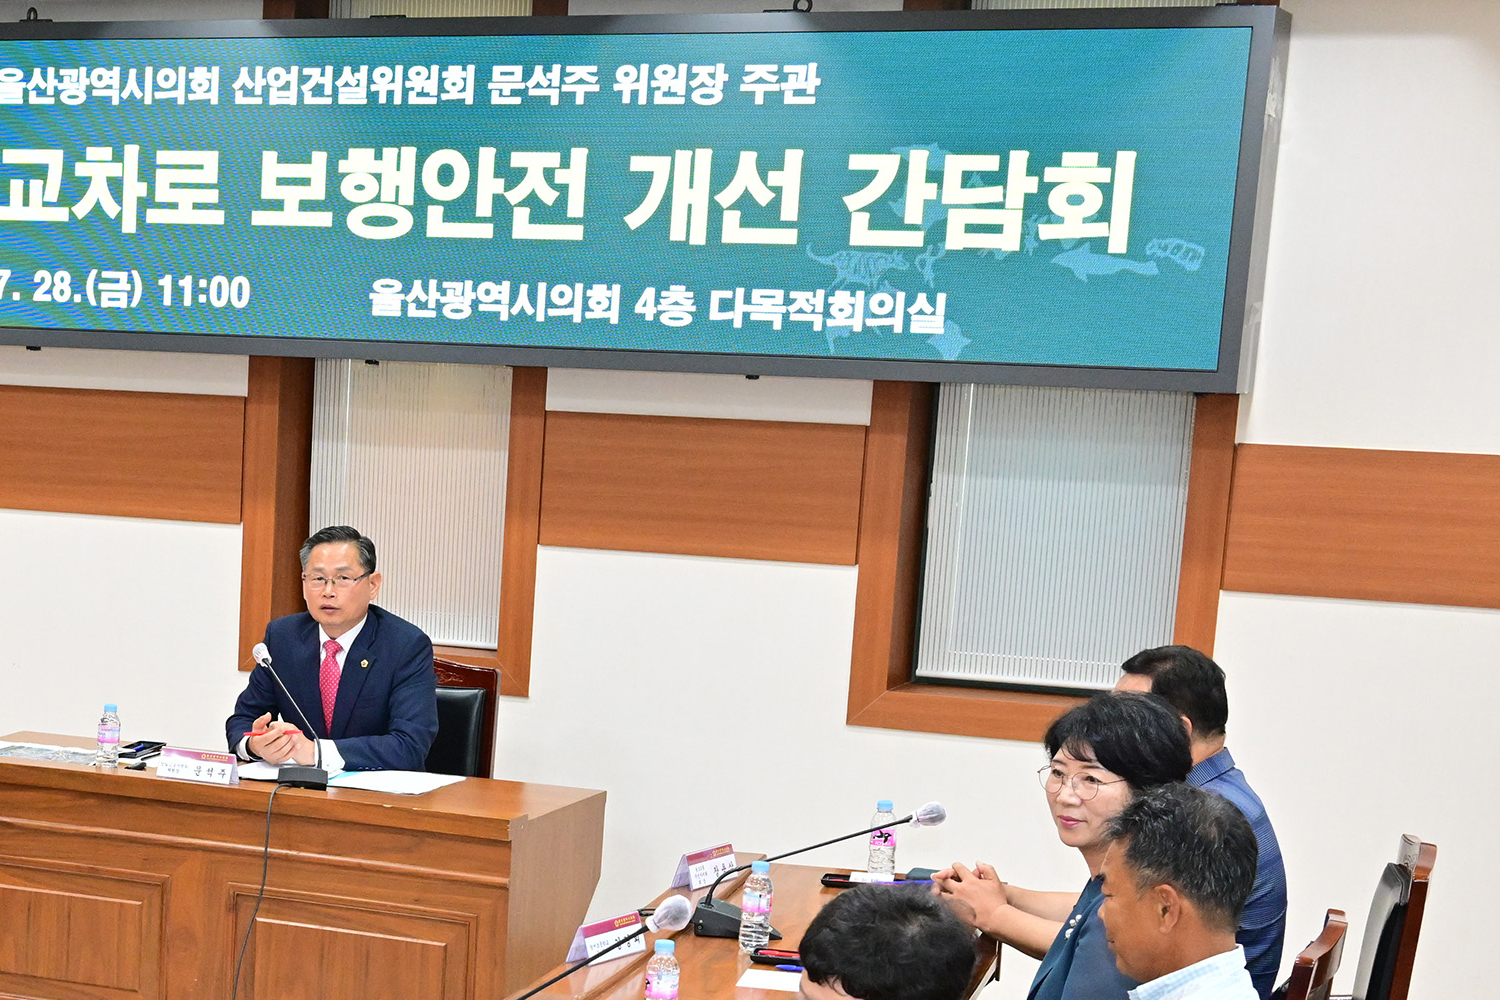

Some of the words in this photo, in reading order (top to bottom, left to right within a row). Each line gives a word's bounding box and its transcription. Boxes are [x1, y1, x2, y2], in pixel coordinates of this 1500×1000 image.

[231, 64, 476, 106] 산업건설위원회
[487, 64, 600, 106] 문석주
[613, 63, 729, 106] 위원장
[739, 62, 822, 105] 주관
[251, 146, 589, 241] 보행안전
[623, 148, 804, 246] 개선
[842, 149, 1137, 254] 간담회
[32, 269, 143, 309] 28.(금)
[158, 274, 251, 309] 11:00
[369, 278, 621, 325] 울산광역시의회
[634, 284, 697, 327] 4층
[709, 287, 947, 335] 다목적회의실
